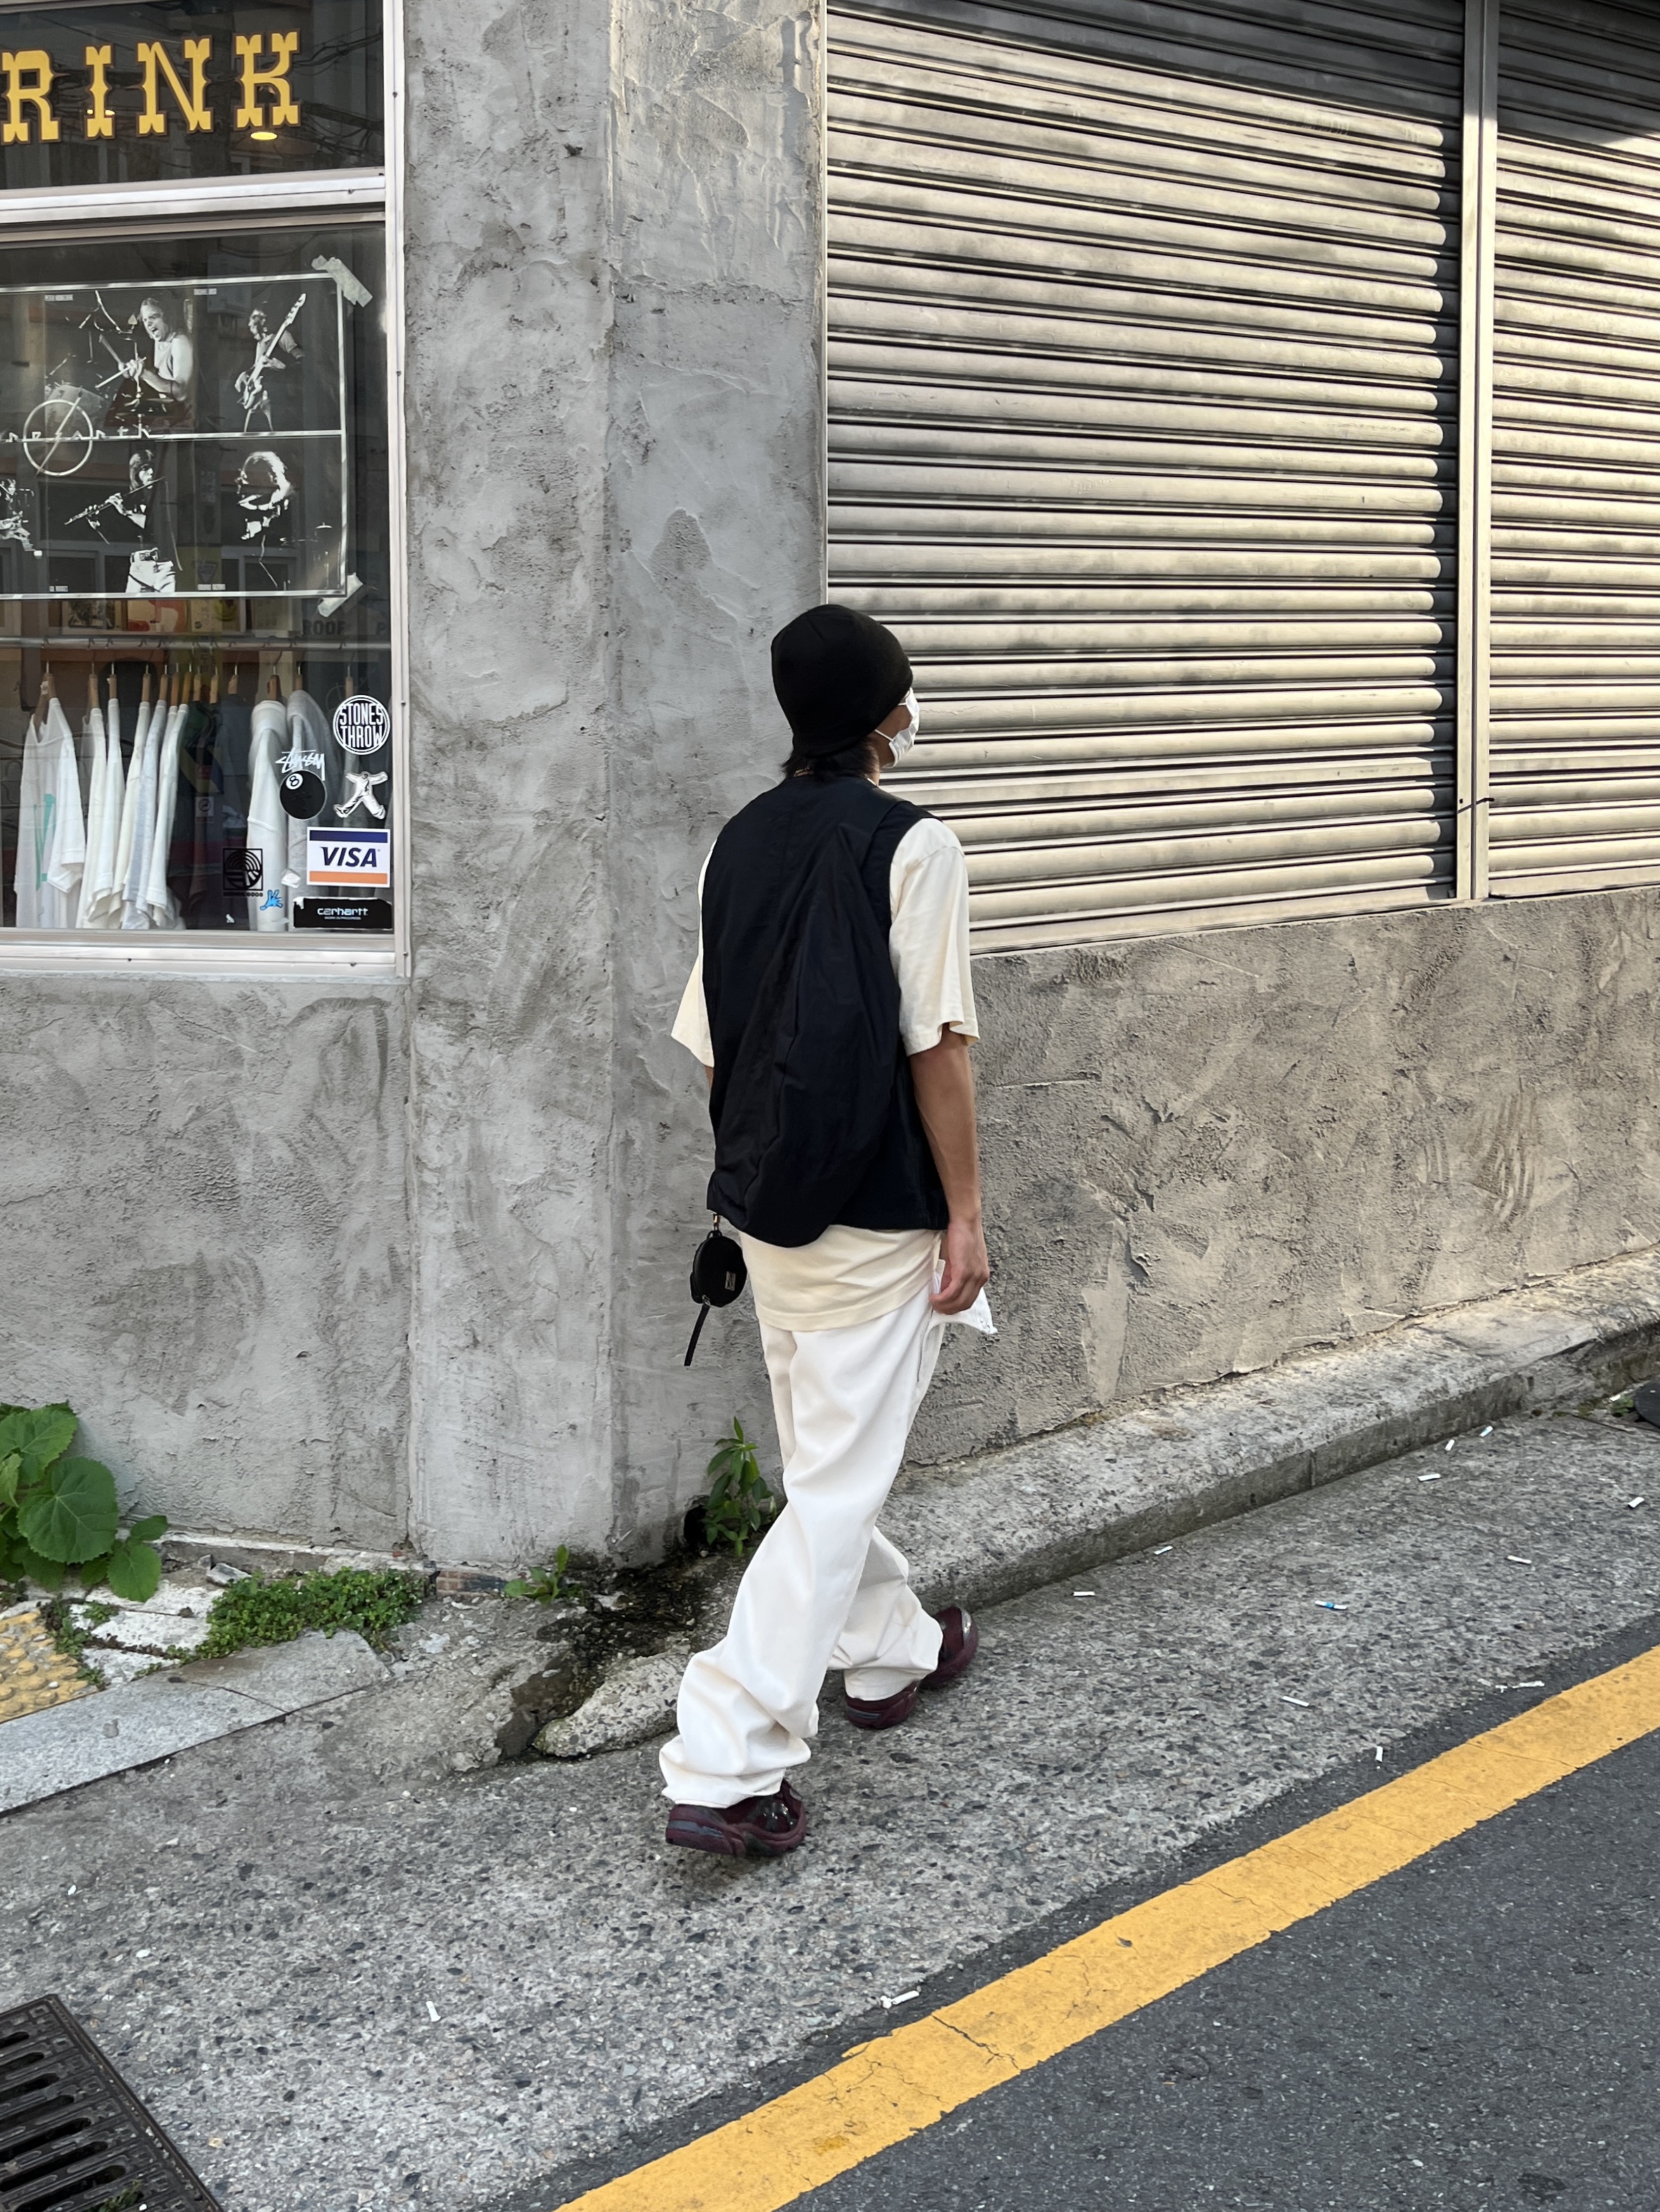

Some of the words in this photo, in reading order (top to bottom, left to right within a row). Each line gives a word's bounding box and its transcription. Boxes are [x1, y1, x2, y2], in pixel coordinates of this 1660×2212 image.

[1, 30, 301, 144] RINK
[339, 703, 384, 725] STONES
[340, 725, 382, 748] THROW
[289, 775, 300, 787] 8
[320, 846, 378, 868] VISA
[317, 907, 368, 916] carhartt
